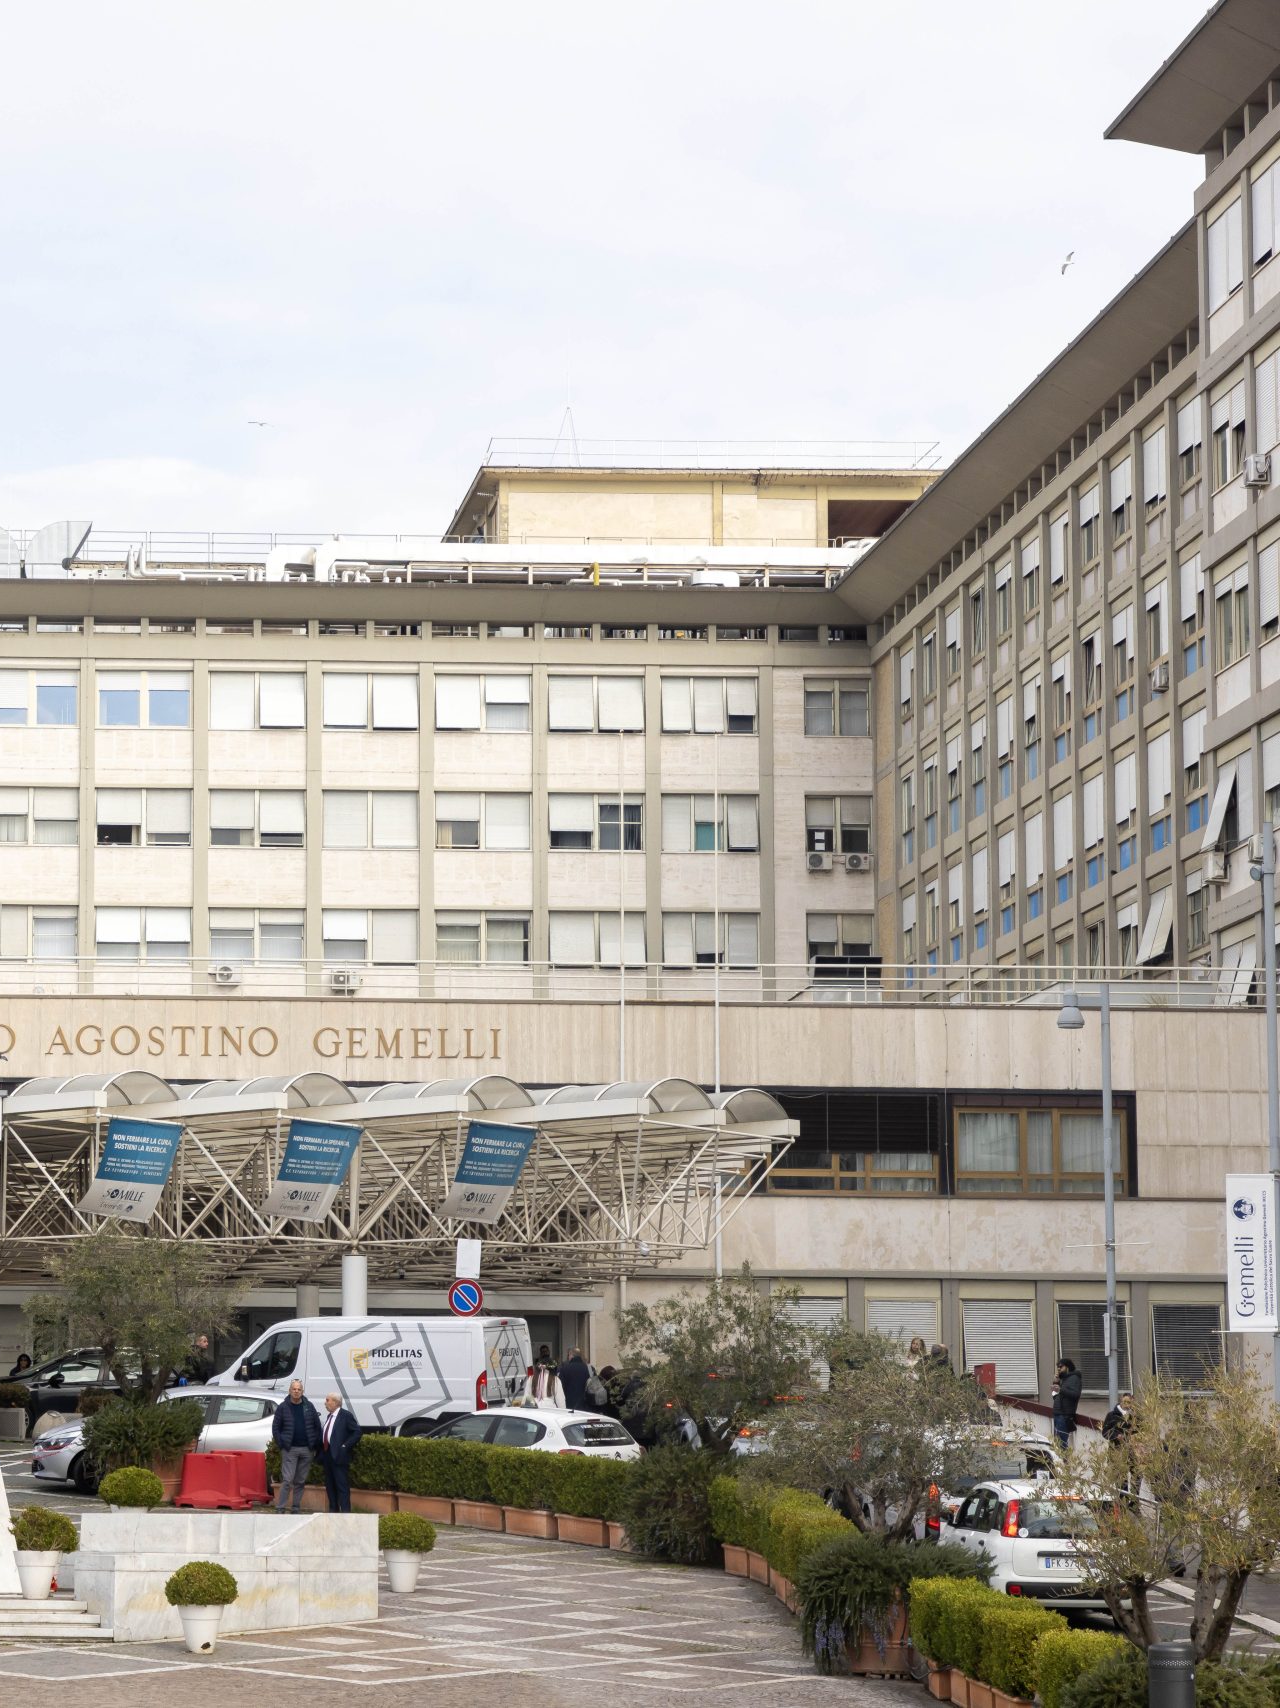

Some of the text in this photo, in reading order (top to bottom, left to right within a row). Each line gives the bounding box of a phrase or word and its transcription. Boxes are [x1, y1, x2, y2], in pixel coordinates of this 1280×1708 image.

[44, 1024, 280, 1058] AGOSTINO
[312, 1026, 503, 1060] GEMELLI
[1234, 1236, 1256, 1318] Gemelli
[371, 1348, 423, 1359] FIDELITAS
